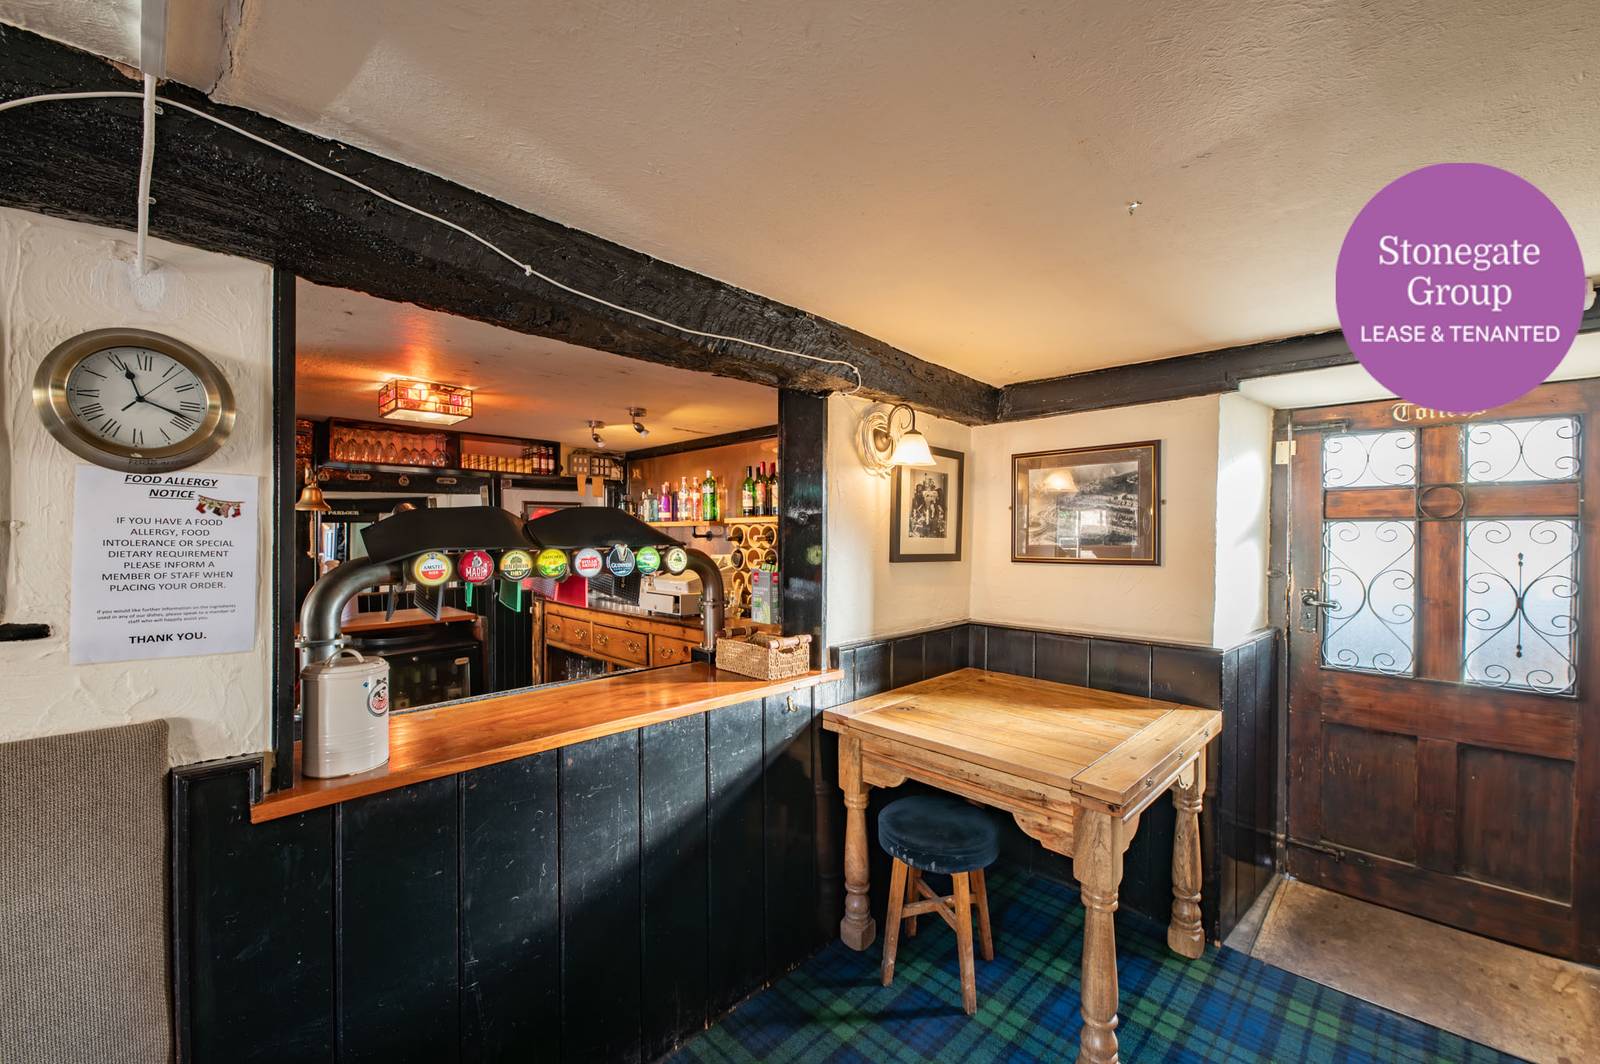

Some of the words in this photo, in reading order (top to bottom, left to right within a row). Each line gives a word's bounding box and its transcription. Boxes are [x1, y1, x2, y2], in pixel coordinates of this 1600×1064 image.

[124, 474, 161, 484] FOOD
[165, 477, 218, 487] ALLERGY
[149, 489, 195, 499] NOTICE
[131, 529, 178, 537] ALLERGY,
[156, 550, 229, 558] REQUIREMENT
[124, 561, 160, 569] PLEASE
[102, 573, 151, 581] MEMBER
[110, 584, 155, 592] PLACING
[158, 583, 187, 591] YOUR
[129, 634, 173, 644] THANK
[177, 632, 207, 640] YOU.
